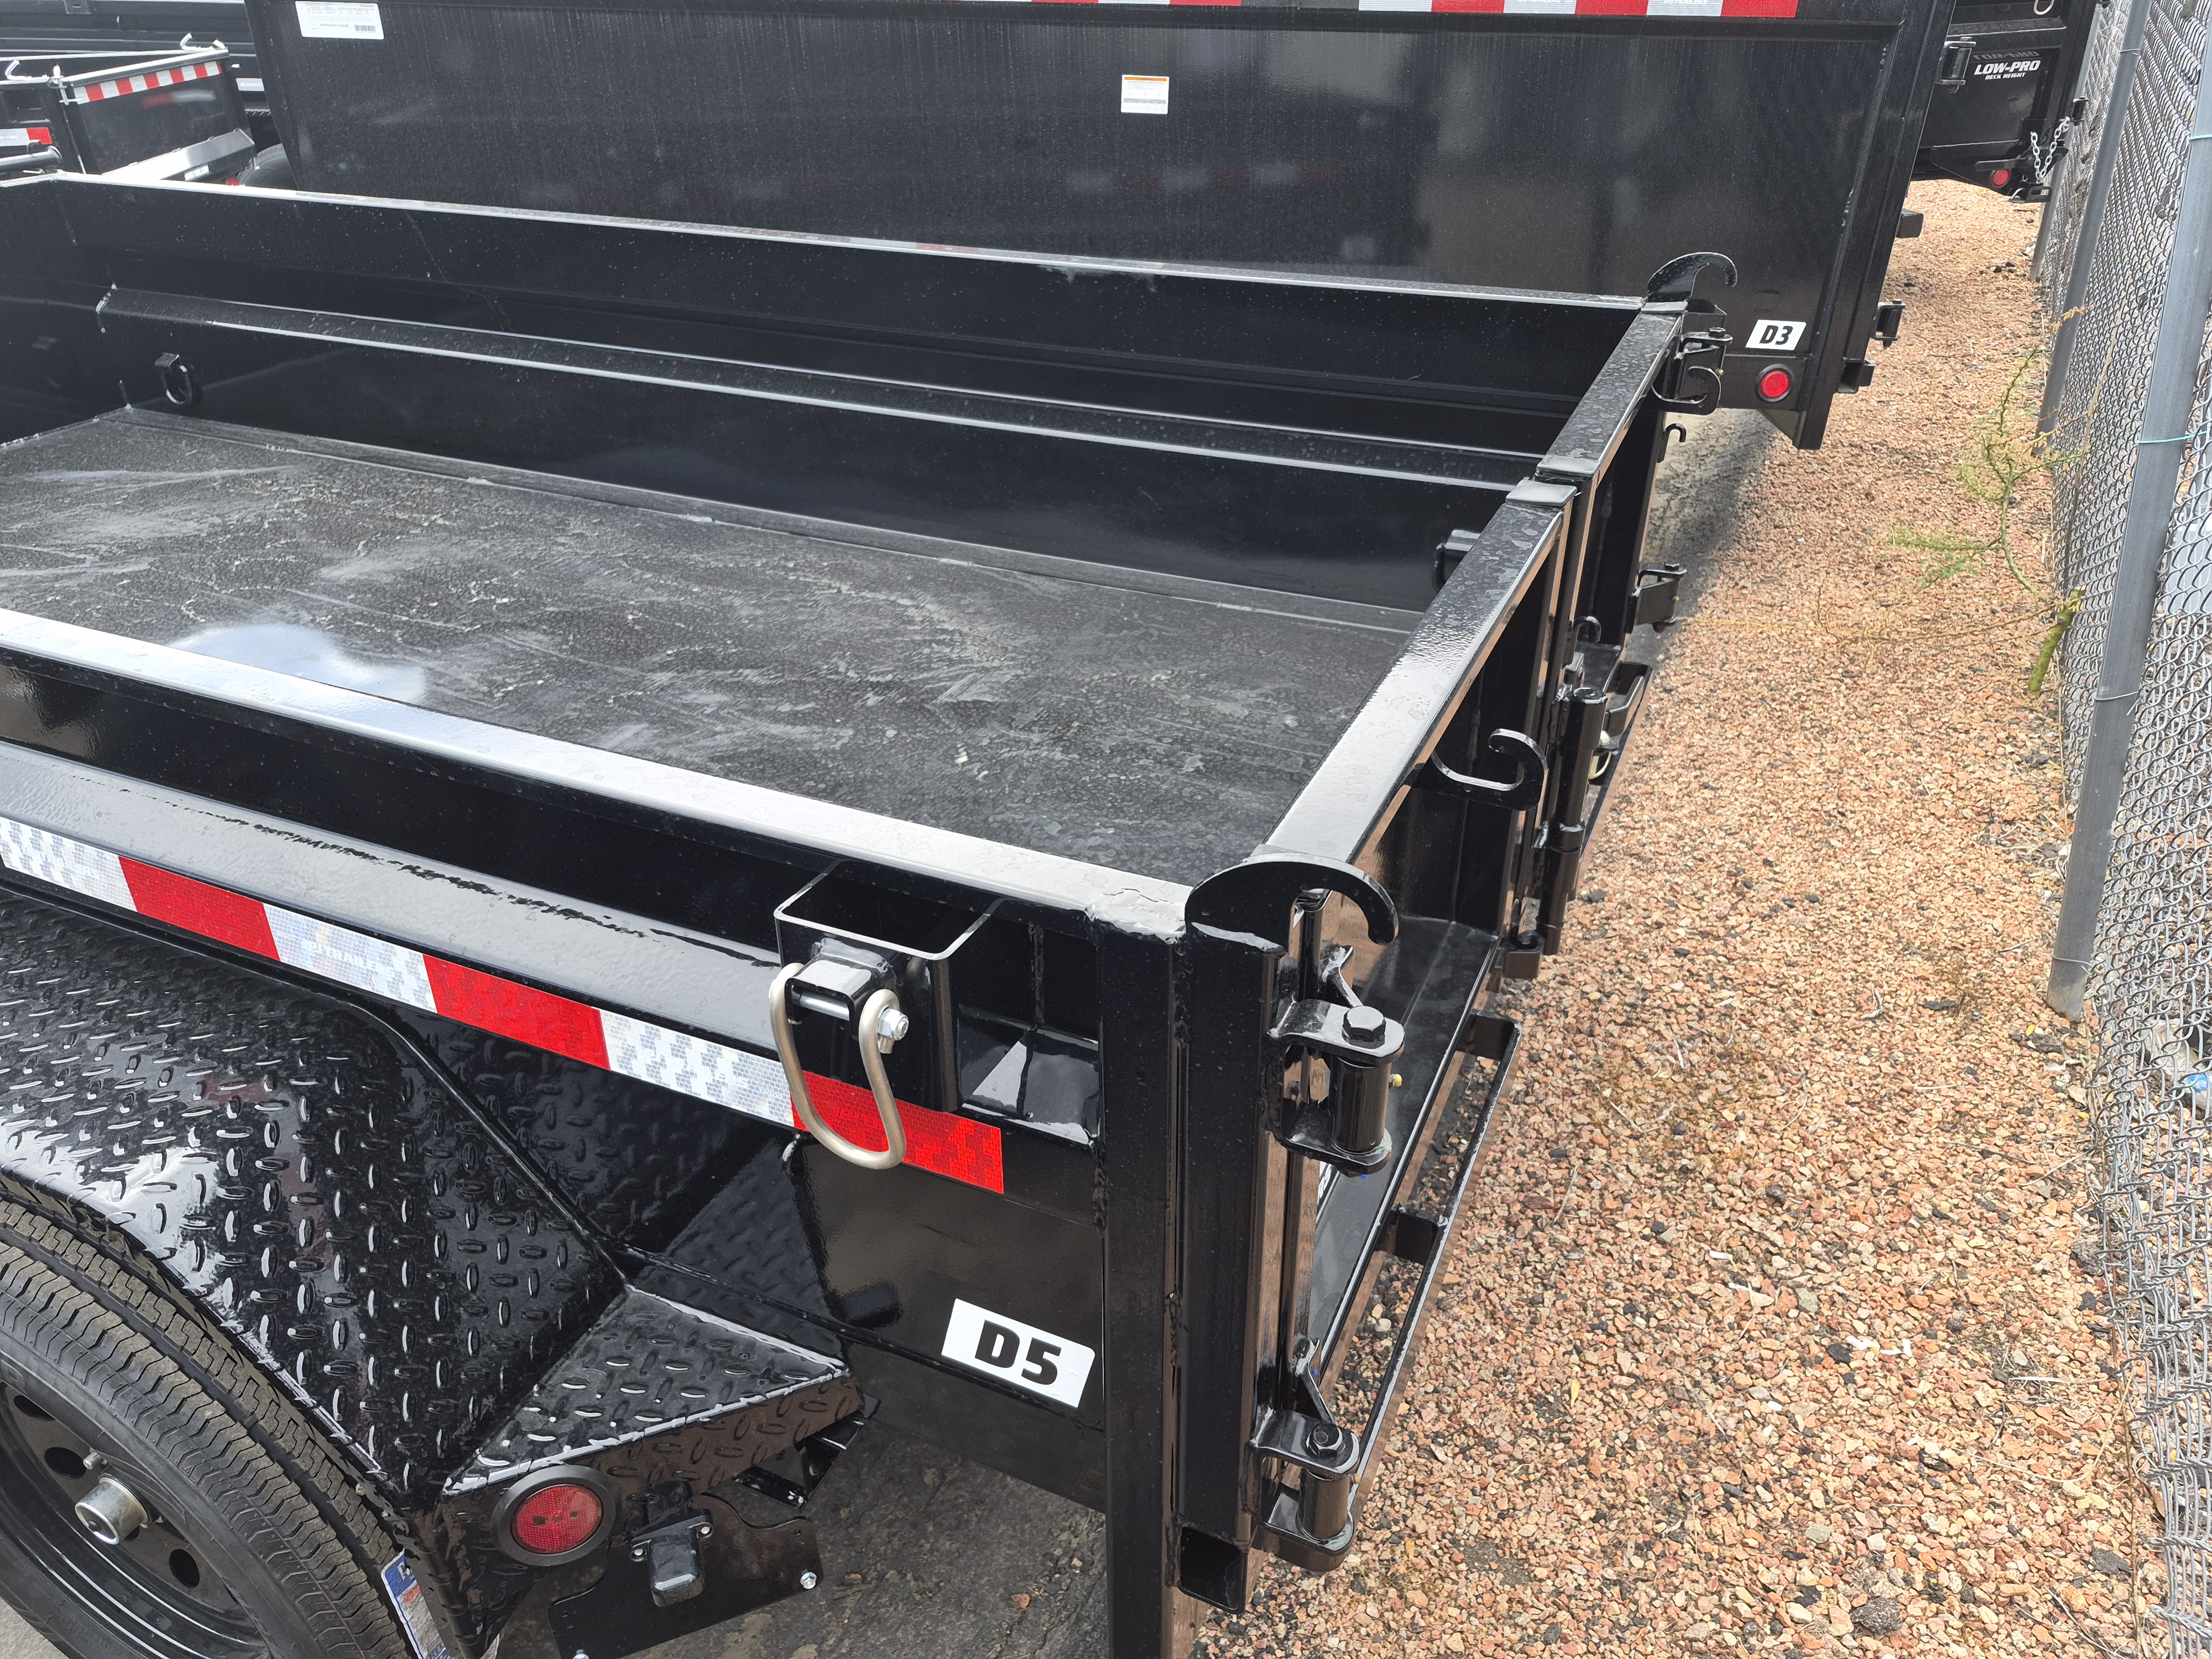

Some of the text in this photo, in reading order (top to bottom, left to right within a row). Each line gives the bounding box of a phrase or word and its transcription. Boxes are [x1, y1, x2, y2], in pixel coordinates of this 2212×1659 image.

[1974, 60, 2041, 75] LOW-PRO
[1759, 325, 1793, 345] D3
[974, 1319, 1061, 1385] D5
